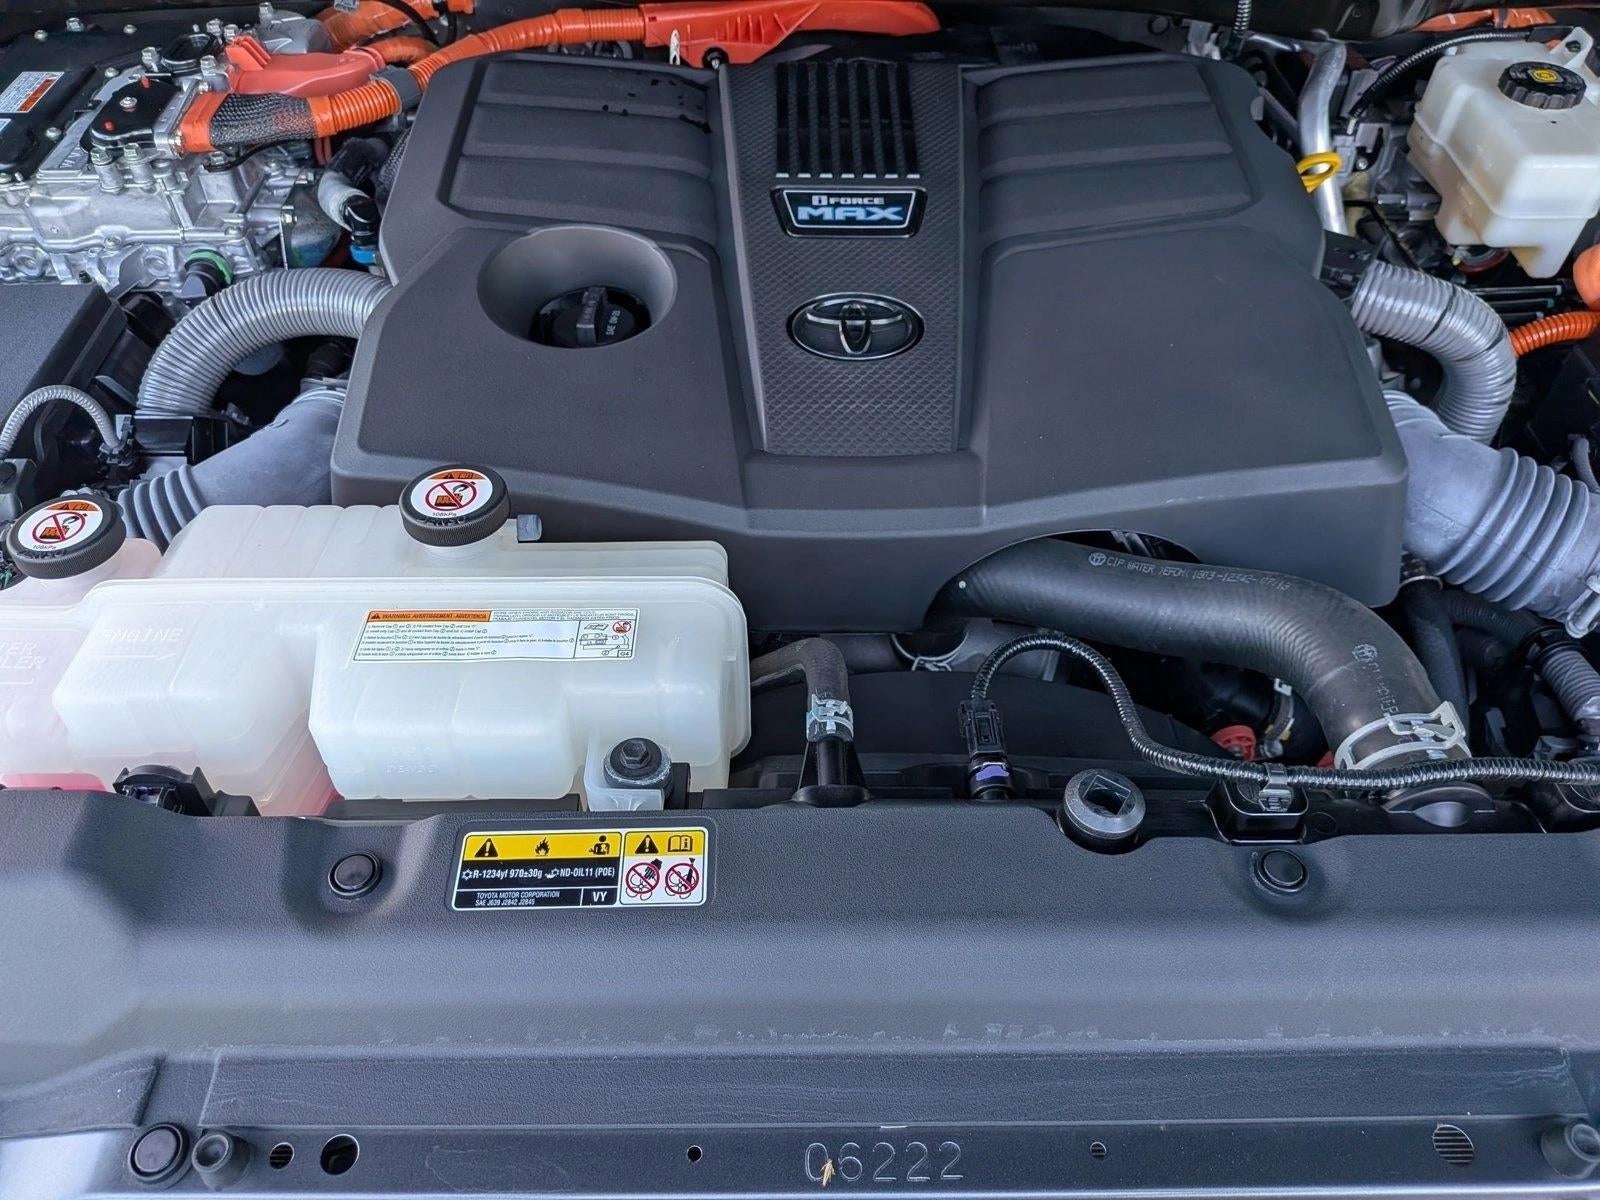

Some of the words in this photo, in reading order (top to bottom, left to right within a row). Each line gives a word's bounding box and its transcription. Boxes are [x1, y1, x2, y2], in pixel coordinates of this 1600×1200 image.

[797, 206, 904, 221] MAX
[472, 868, 508, 880] R-1234yf
[509, 868, 543, 879] 970±30g
[560, 867, 593, 877] ND-OIL11
[595, 866, 615, 878] (POE)
[476, 891, 498, 899] TOYOTA
[499, 891, 520, 899] MOTOR
[520, 890, 560, 898] CORPORATION
[592, 891, 608, 902] VY
[804, 1141, 964, 1182] 06222
